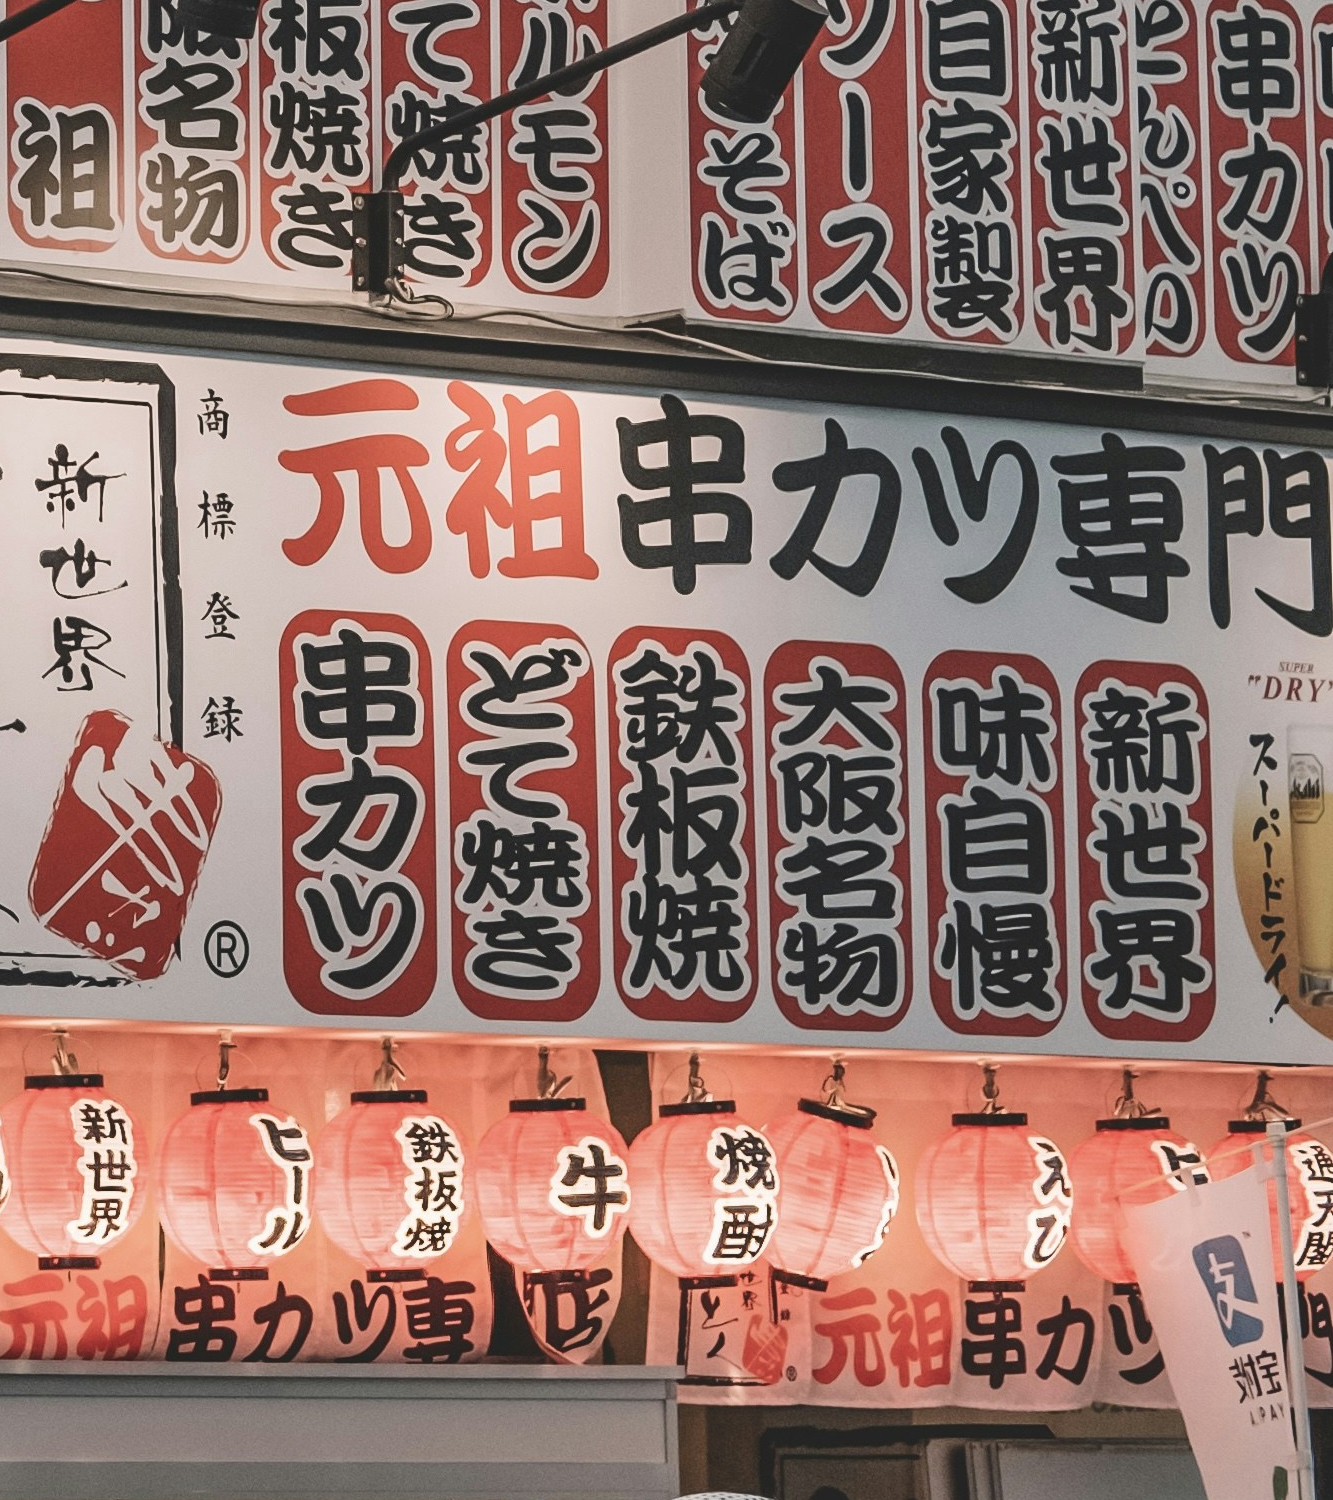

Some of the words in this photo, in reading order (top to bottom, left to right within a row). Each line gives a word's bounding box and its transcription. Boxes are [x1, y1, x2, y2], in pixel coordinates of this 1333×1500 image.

[1217, 5, 1299, 354] 串カツ
[34, 443, 129, 692] 新世界
[195, 387, 245, 743] 商標登録
[276, 379, 1333, 638] 元祖串カツ専門
[300, 628, 417, 990] 串カツ
[461, 646, 583, 992] どて焼き
[620, 648, 744, 993] 鉄板焼
[777, 664, 897, 1009] 大阪名物
[937, 673, 1056, 1012] 味自慢
[1088, 686, 1208, 1013] 新世界
[77, 1103, 132, 1238] 新世界
[404, 1121, 458, 1254] 鉄板焼
[558, 1144, 627, 1231] 牛
[714, 1130, 775, 1260] 焼酎
